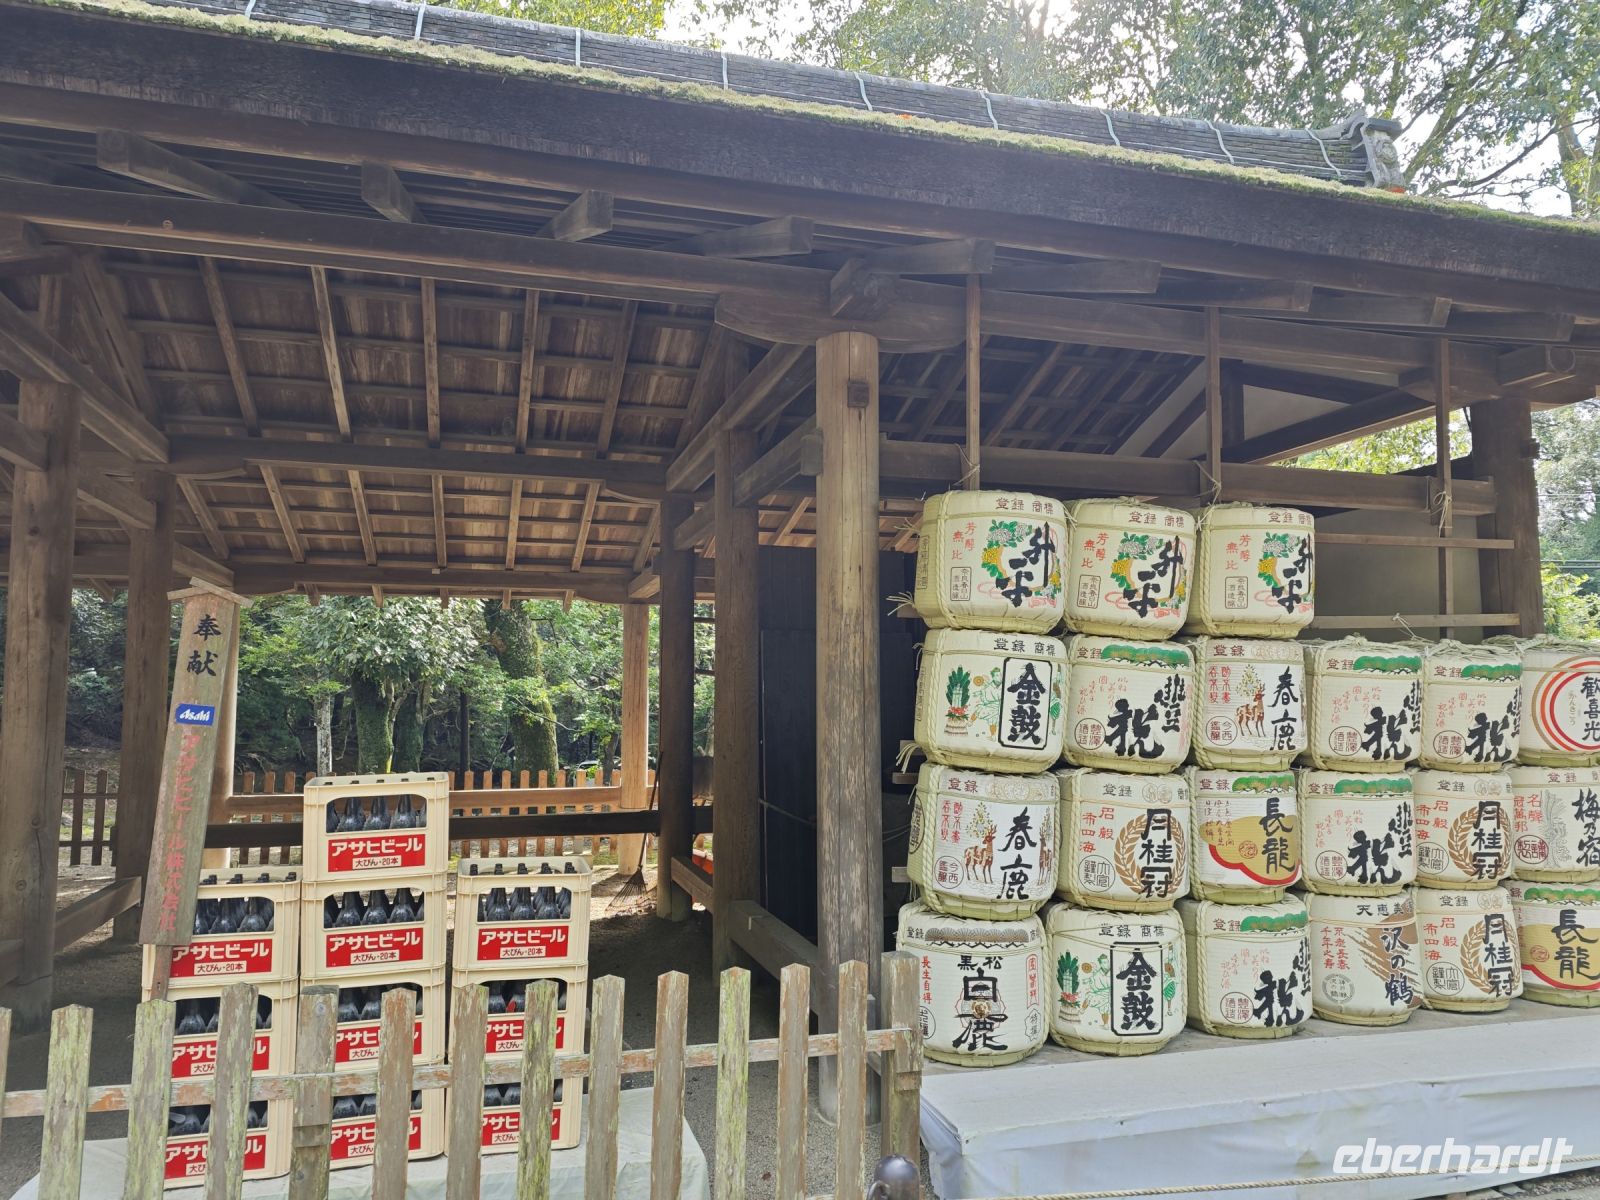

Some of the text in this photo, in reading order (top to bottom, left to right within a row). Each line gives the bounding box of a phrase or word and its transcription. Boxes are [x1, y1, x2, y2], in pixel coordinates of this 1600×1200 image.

[186, 614, 222, 677] 奉献
[1213, 644, 1245, 657] 登録
[179, 708, 210, 722] Asahi
[1006, 662, 1047, 745] 金鼓
[1267, 665, 1299, 751] 春鹿
[948, 777, 978, 794] 登録
[331, 837, 423, 857] アサヒビール
[996, 806, 1037, 900] 春鹿
[1139, 808, 1174, 898] 月桂冠
[1259, 797, 1296, 874] 長龍
[1471, 800, 1503, 880] 月桂冠
[173, 942, 270, 962] アサヒビール
[329, 931, 420, 952] アサヒビール
[481, 929, 566, 946] アサヒビール
[957, 955, 1003, 970] 黒松
[1483, 913, 1513, 998] 月桂冠
[1551, 909, 1600, 980] 長龍
[952, 966, 1008, 1051] 白鹿
[1115, 948, 1158, 1031] 金鼓
